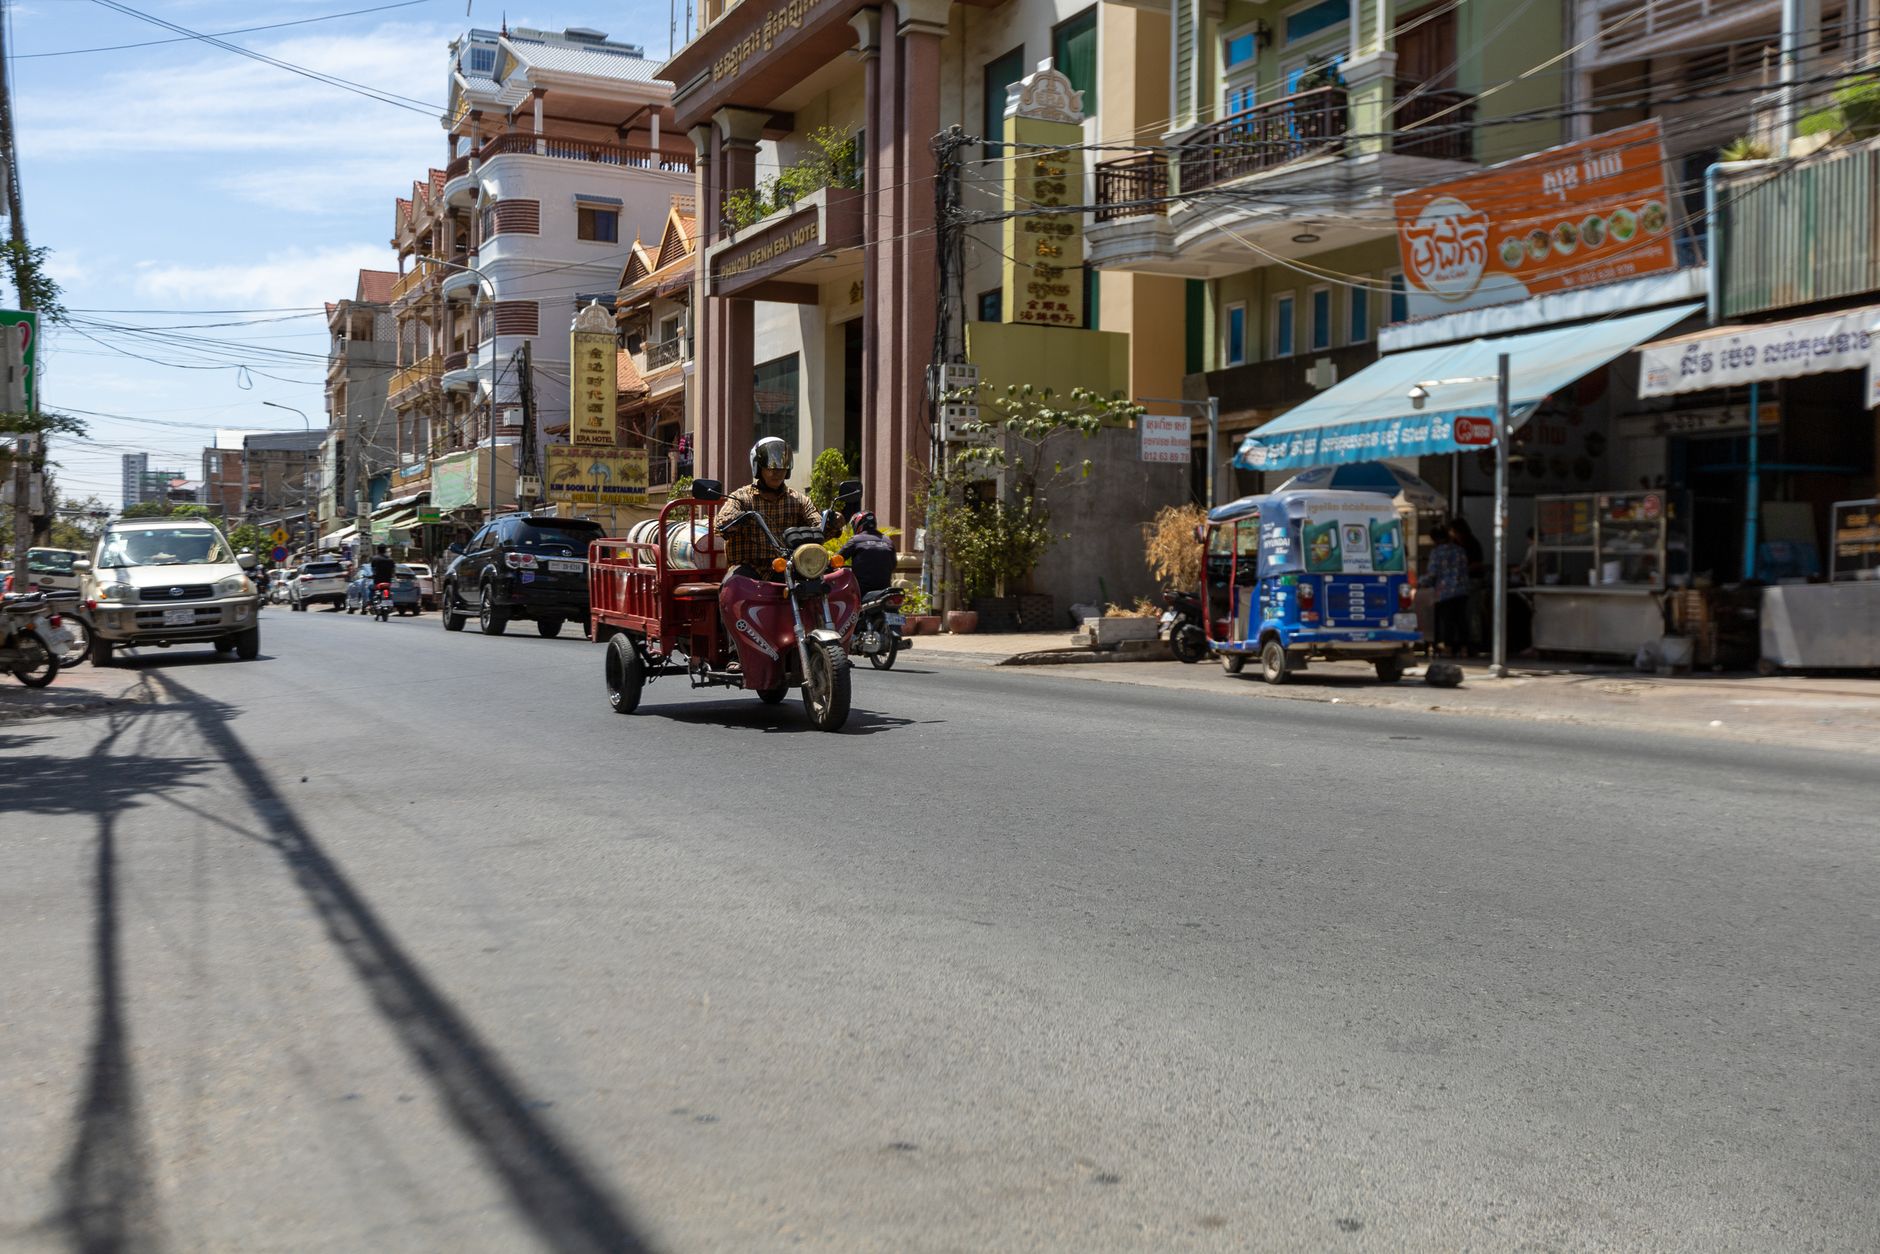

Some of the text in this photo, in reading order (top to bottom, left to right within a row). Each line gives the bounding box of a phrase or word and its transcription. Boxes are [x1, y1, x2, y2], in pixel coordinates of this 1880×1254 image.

[720, 255, 749, 279] PHNOM
[750, 243, 773, 266] PENH
[774, 234, 791, 255] ERA
[576, 434, 614, 443] ERA HOTEL
[602, 486, 646, 494] RESTAURANT
[1264, 538, 1290, 549] HYUNDAI
